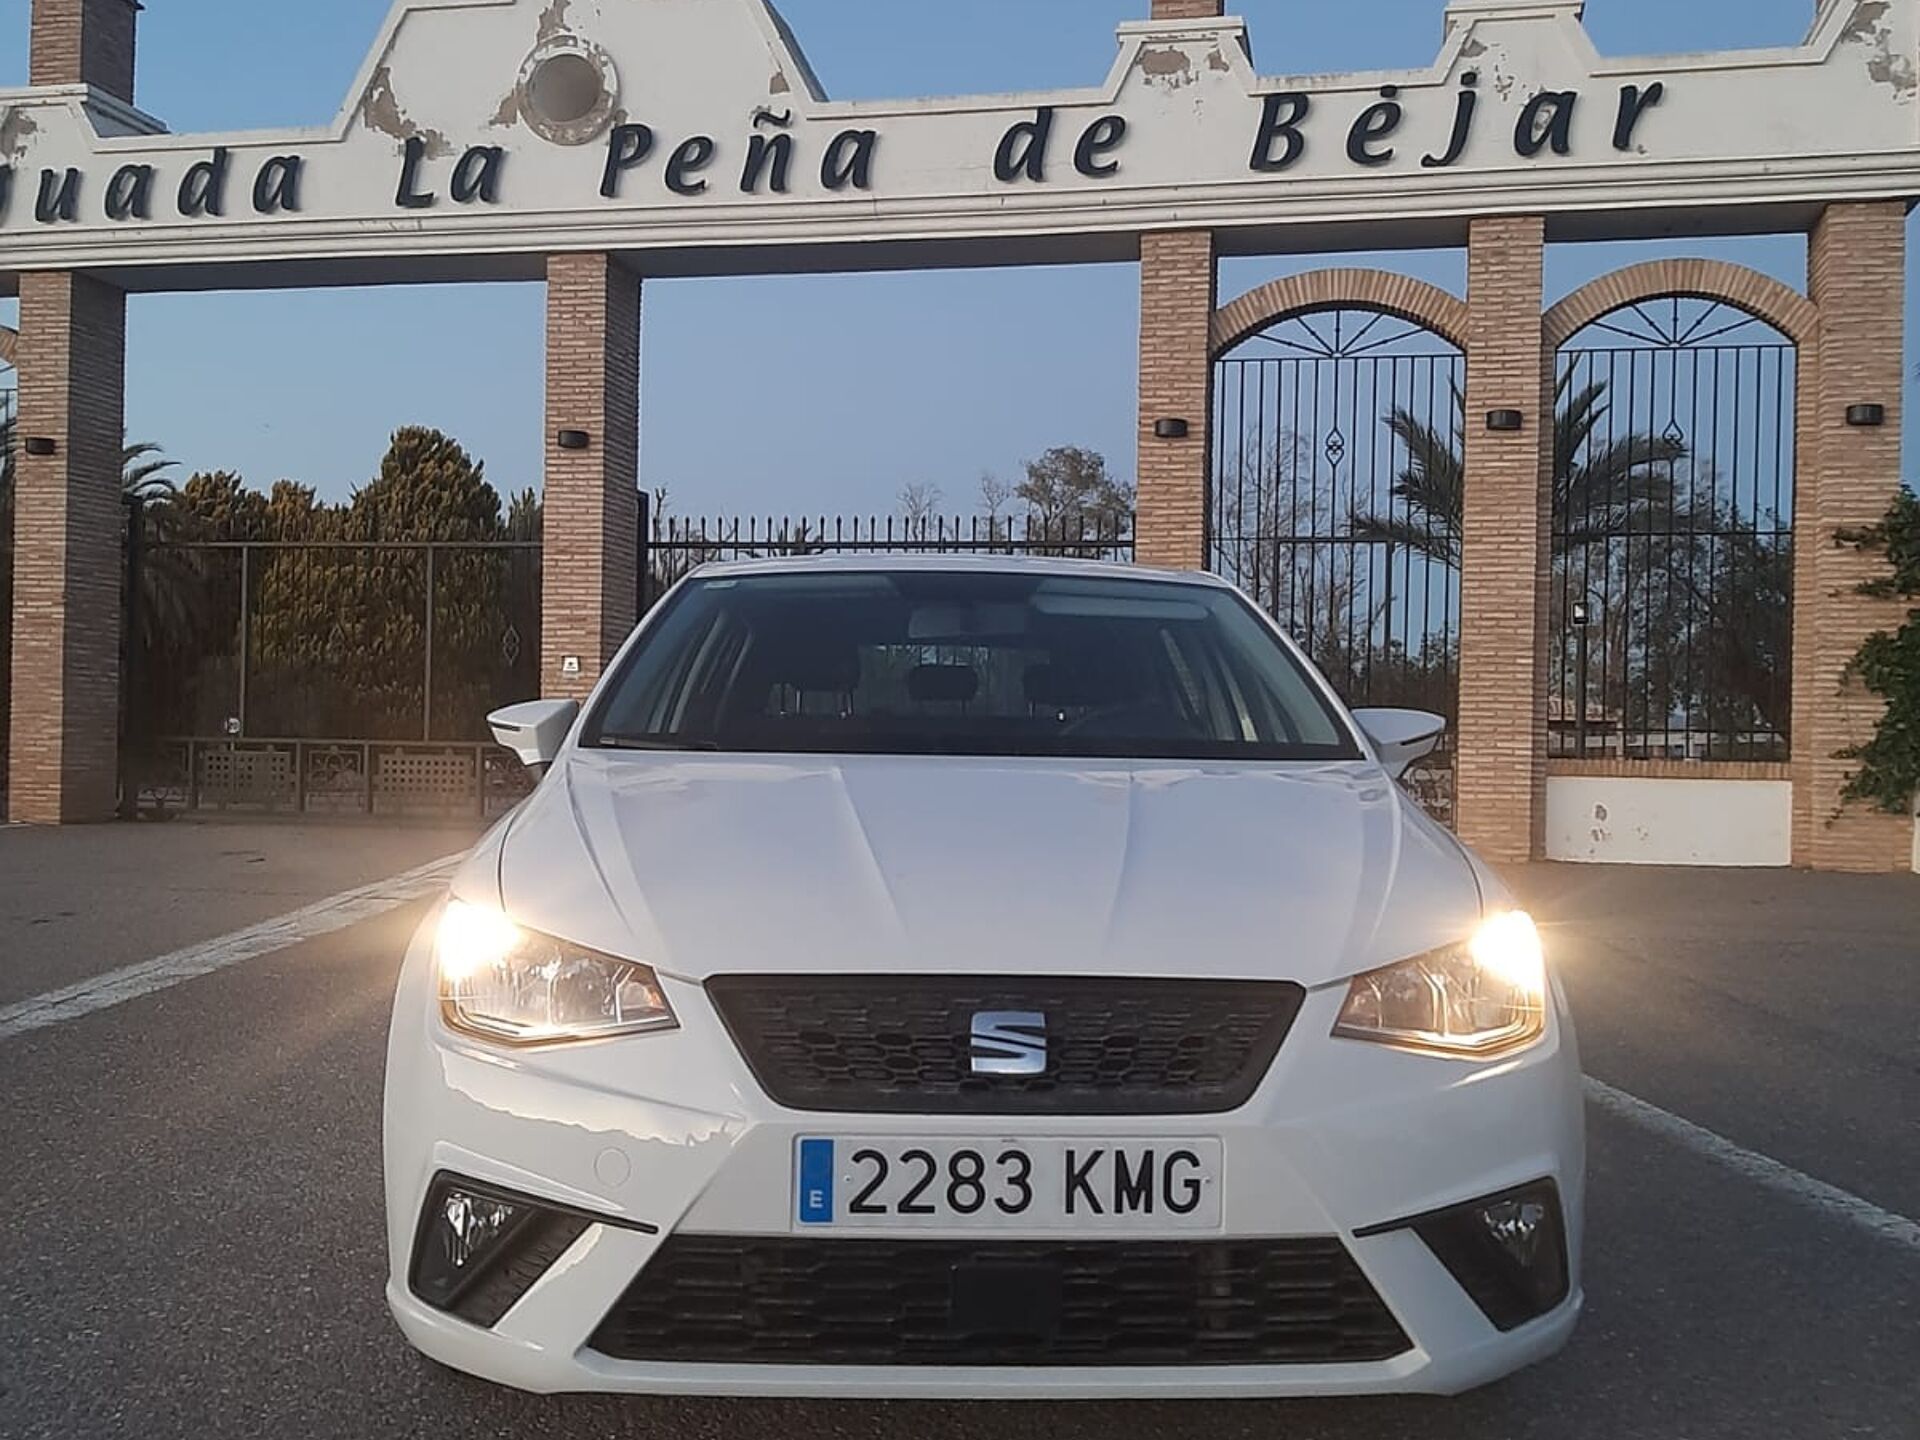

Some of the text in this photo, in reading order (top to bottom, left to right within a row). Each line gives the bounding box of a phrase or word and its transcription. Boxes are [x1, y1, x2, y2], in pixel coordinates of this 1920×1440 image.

[0, 71, 1663, 226] uada La Peña de Béjar
[808, 1149, 1201, 1215] E 2283 KMG
